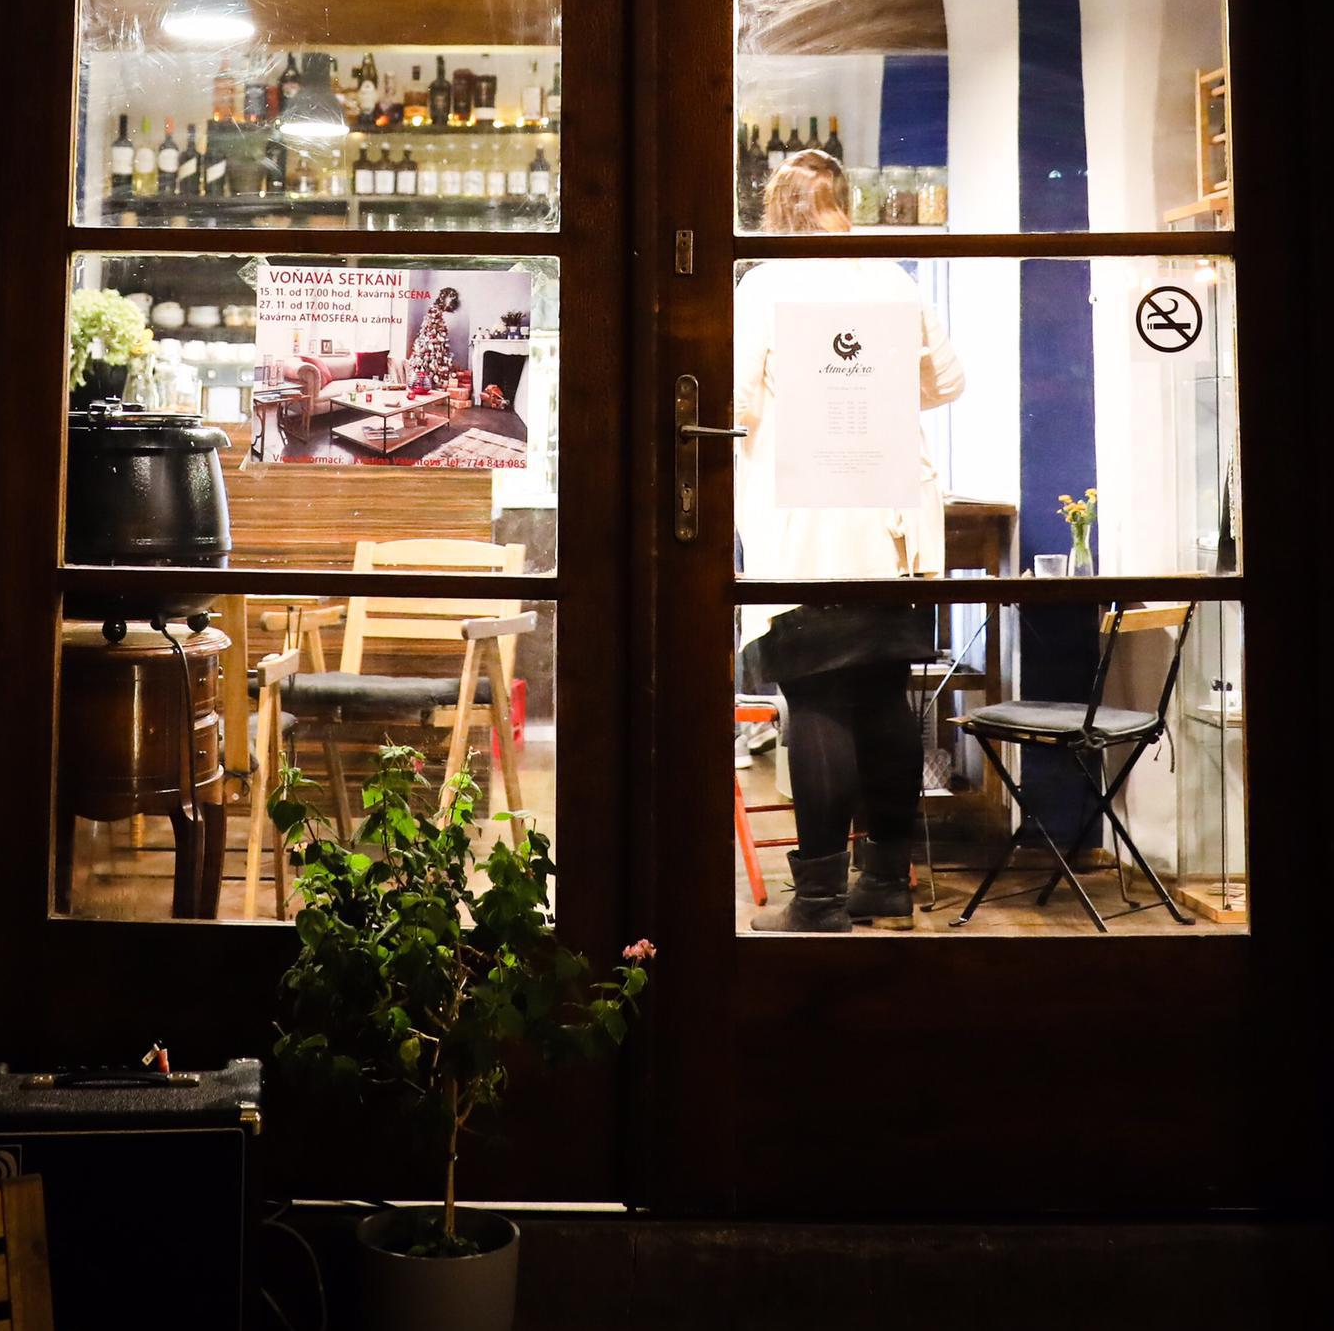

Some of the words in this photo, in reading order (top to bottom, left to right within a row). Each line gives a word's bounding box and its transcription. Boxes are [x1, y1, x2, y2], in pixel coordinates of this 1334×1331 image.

[270, 268, 334, 284] VOŇAVÁ
[339, 270, 403, 286] SETKÁNÍ
[289, 288, 302, 297] od
[305, 288, 328, 298] 17.00
[331, 289, 353, 299] hod.
[358, 289, 396, 299] kavárna
[398, 289, 432, 300] SCÉNA
[290, 301, 303, 310] od
[306, 301, 330, 311] 17.00
[332, 302, 354, 311] hod.
[259, 312, 297, 322] kavárna
[299, 313, 359, 323] ATMOSFÉRA
[371, 315, 403, 324] zámku
[508, 458, 526, 469] 085
